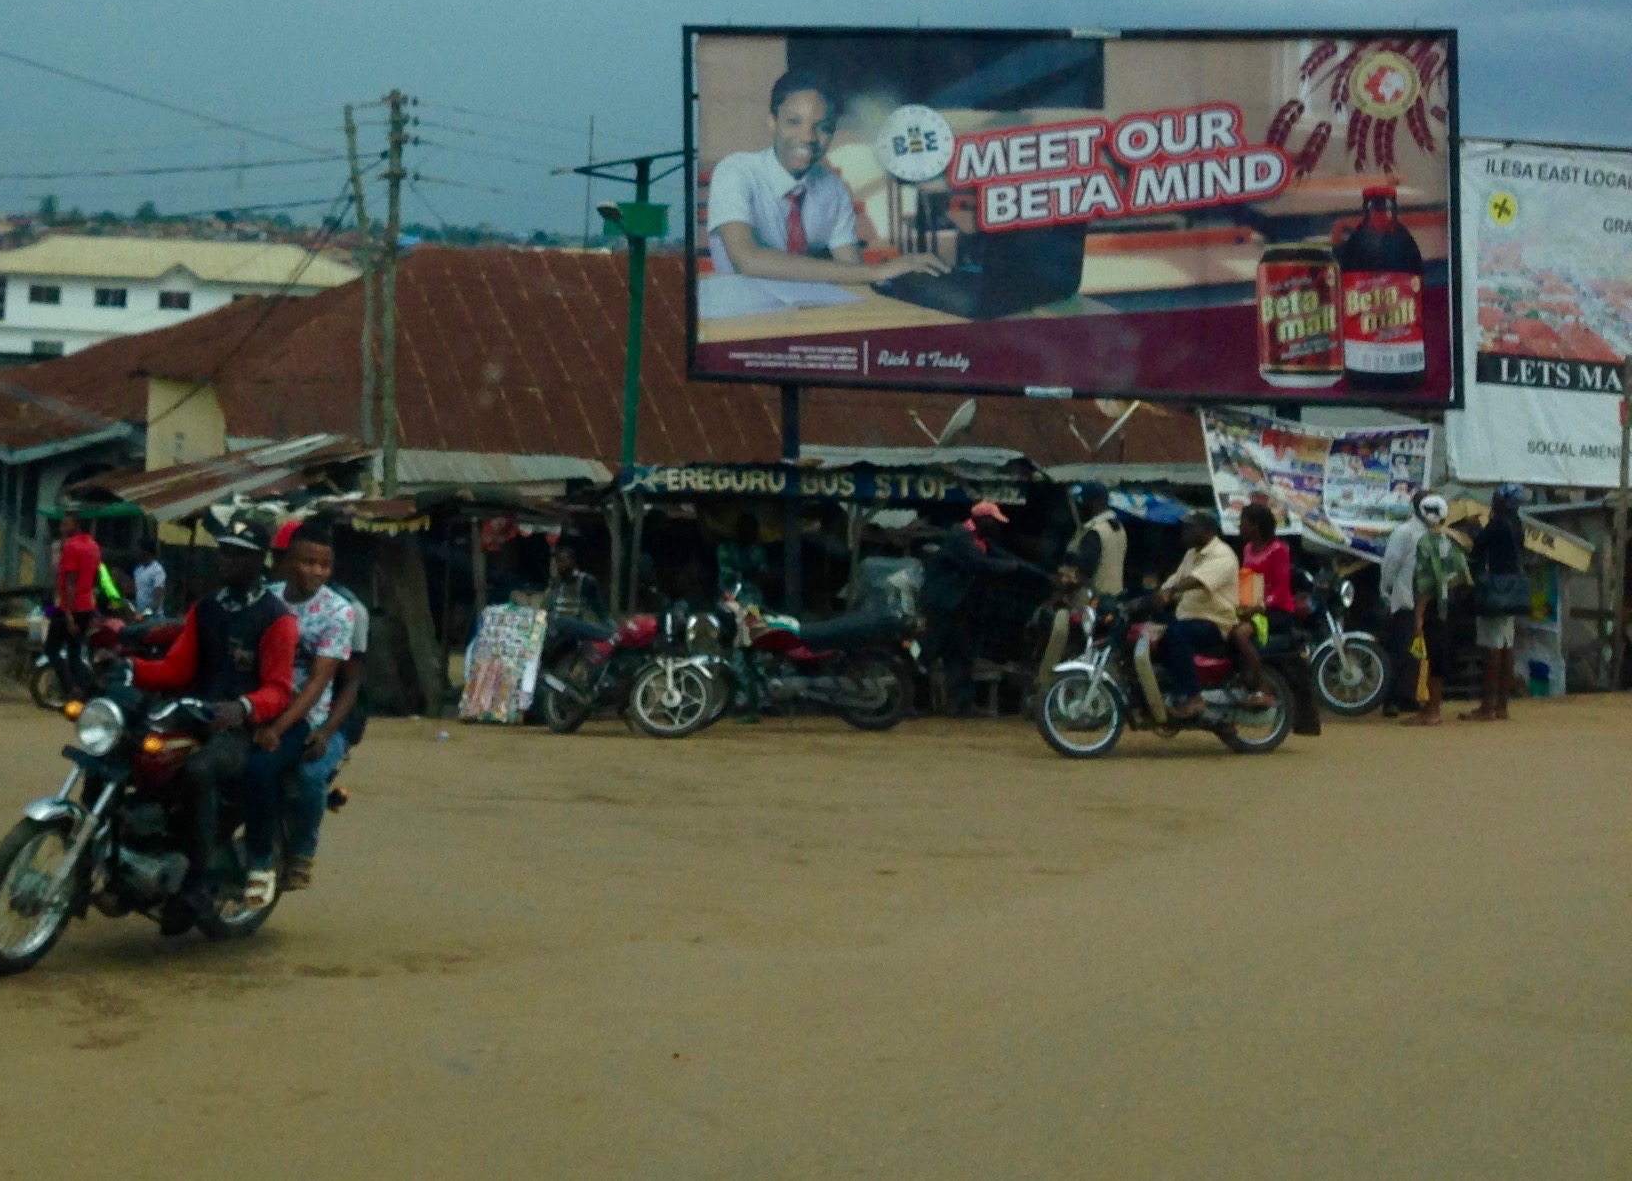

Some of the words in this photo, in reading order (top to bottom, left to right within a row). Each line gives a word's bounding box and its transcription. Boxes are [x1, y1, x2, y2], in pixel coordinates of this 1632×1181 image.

[955, 126, 1101, 181] MEET
[1117, 109, 1236, 160] OUR
[1486, 158, 1533, 180] ILESA
[1537, 162, 1581, 183] EAST
[985, 172, 1120, 225] BETA
[1133, 152, 1284, 208] MIND
[1261, 290, 1318, 323] Beta
[1500, 357, 1570, 387] LETS
[1579, 364, 1623, 391] MA
[1527, 439, 1575, 457] SOCIAL
[666, 468, 786, 493] EREGURU
[800, 472, 855, 496] BUS
